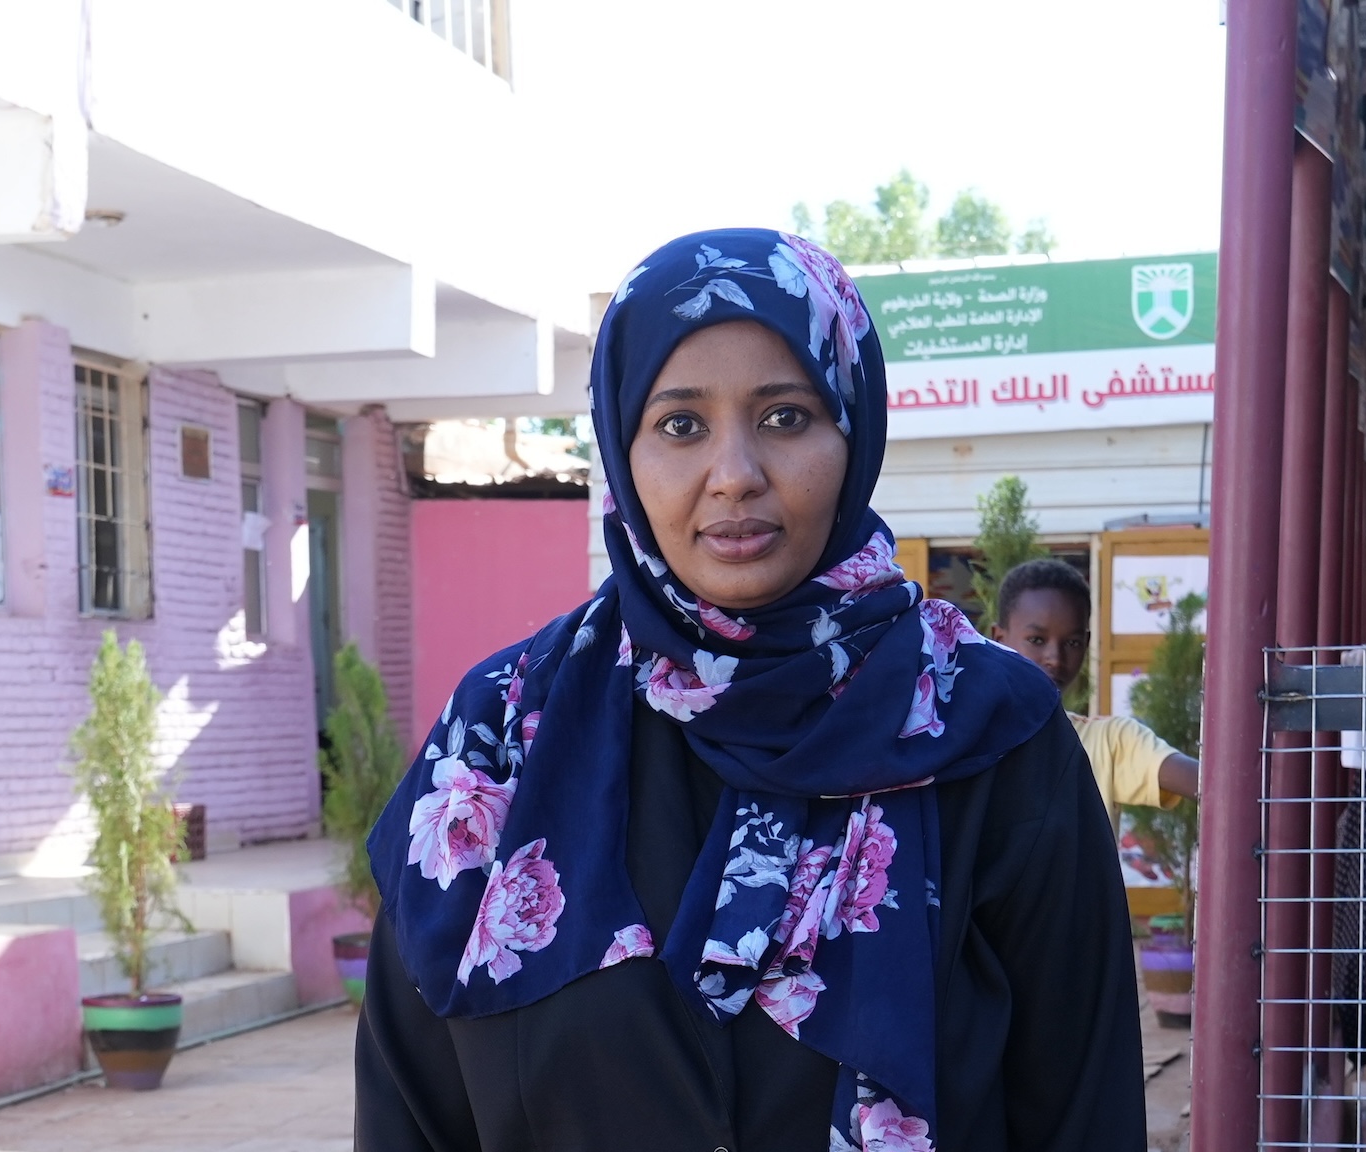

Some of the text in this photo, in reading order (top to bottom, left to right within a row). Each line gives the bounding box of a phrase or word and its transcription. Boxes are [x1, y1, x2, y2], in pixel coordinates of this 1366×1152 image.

[932, 291, 963, 309] ولاية
[978, 287, 1017, 303] الصحة
[1019, 286, 1048, 303] وزارة
[881, 293, 931, 315] الخرطوم
[934, 313, 967, 331] للطب
[969, 309, 1005, 326] العامة
[903, 335, 991, 360] المستشفيات
[991, 374, 1069, 410] البلك
